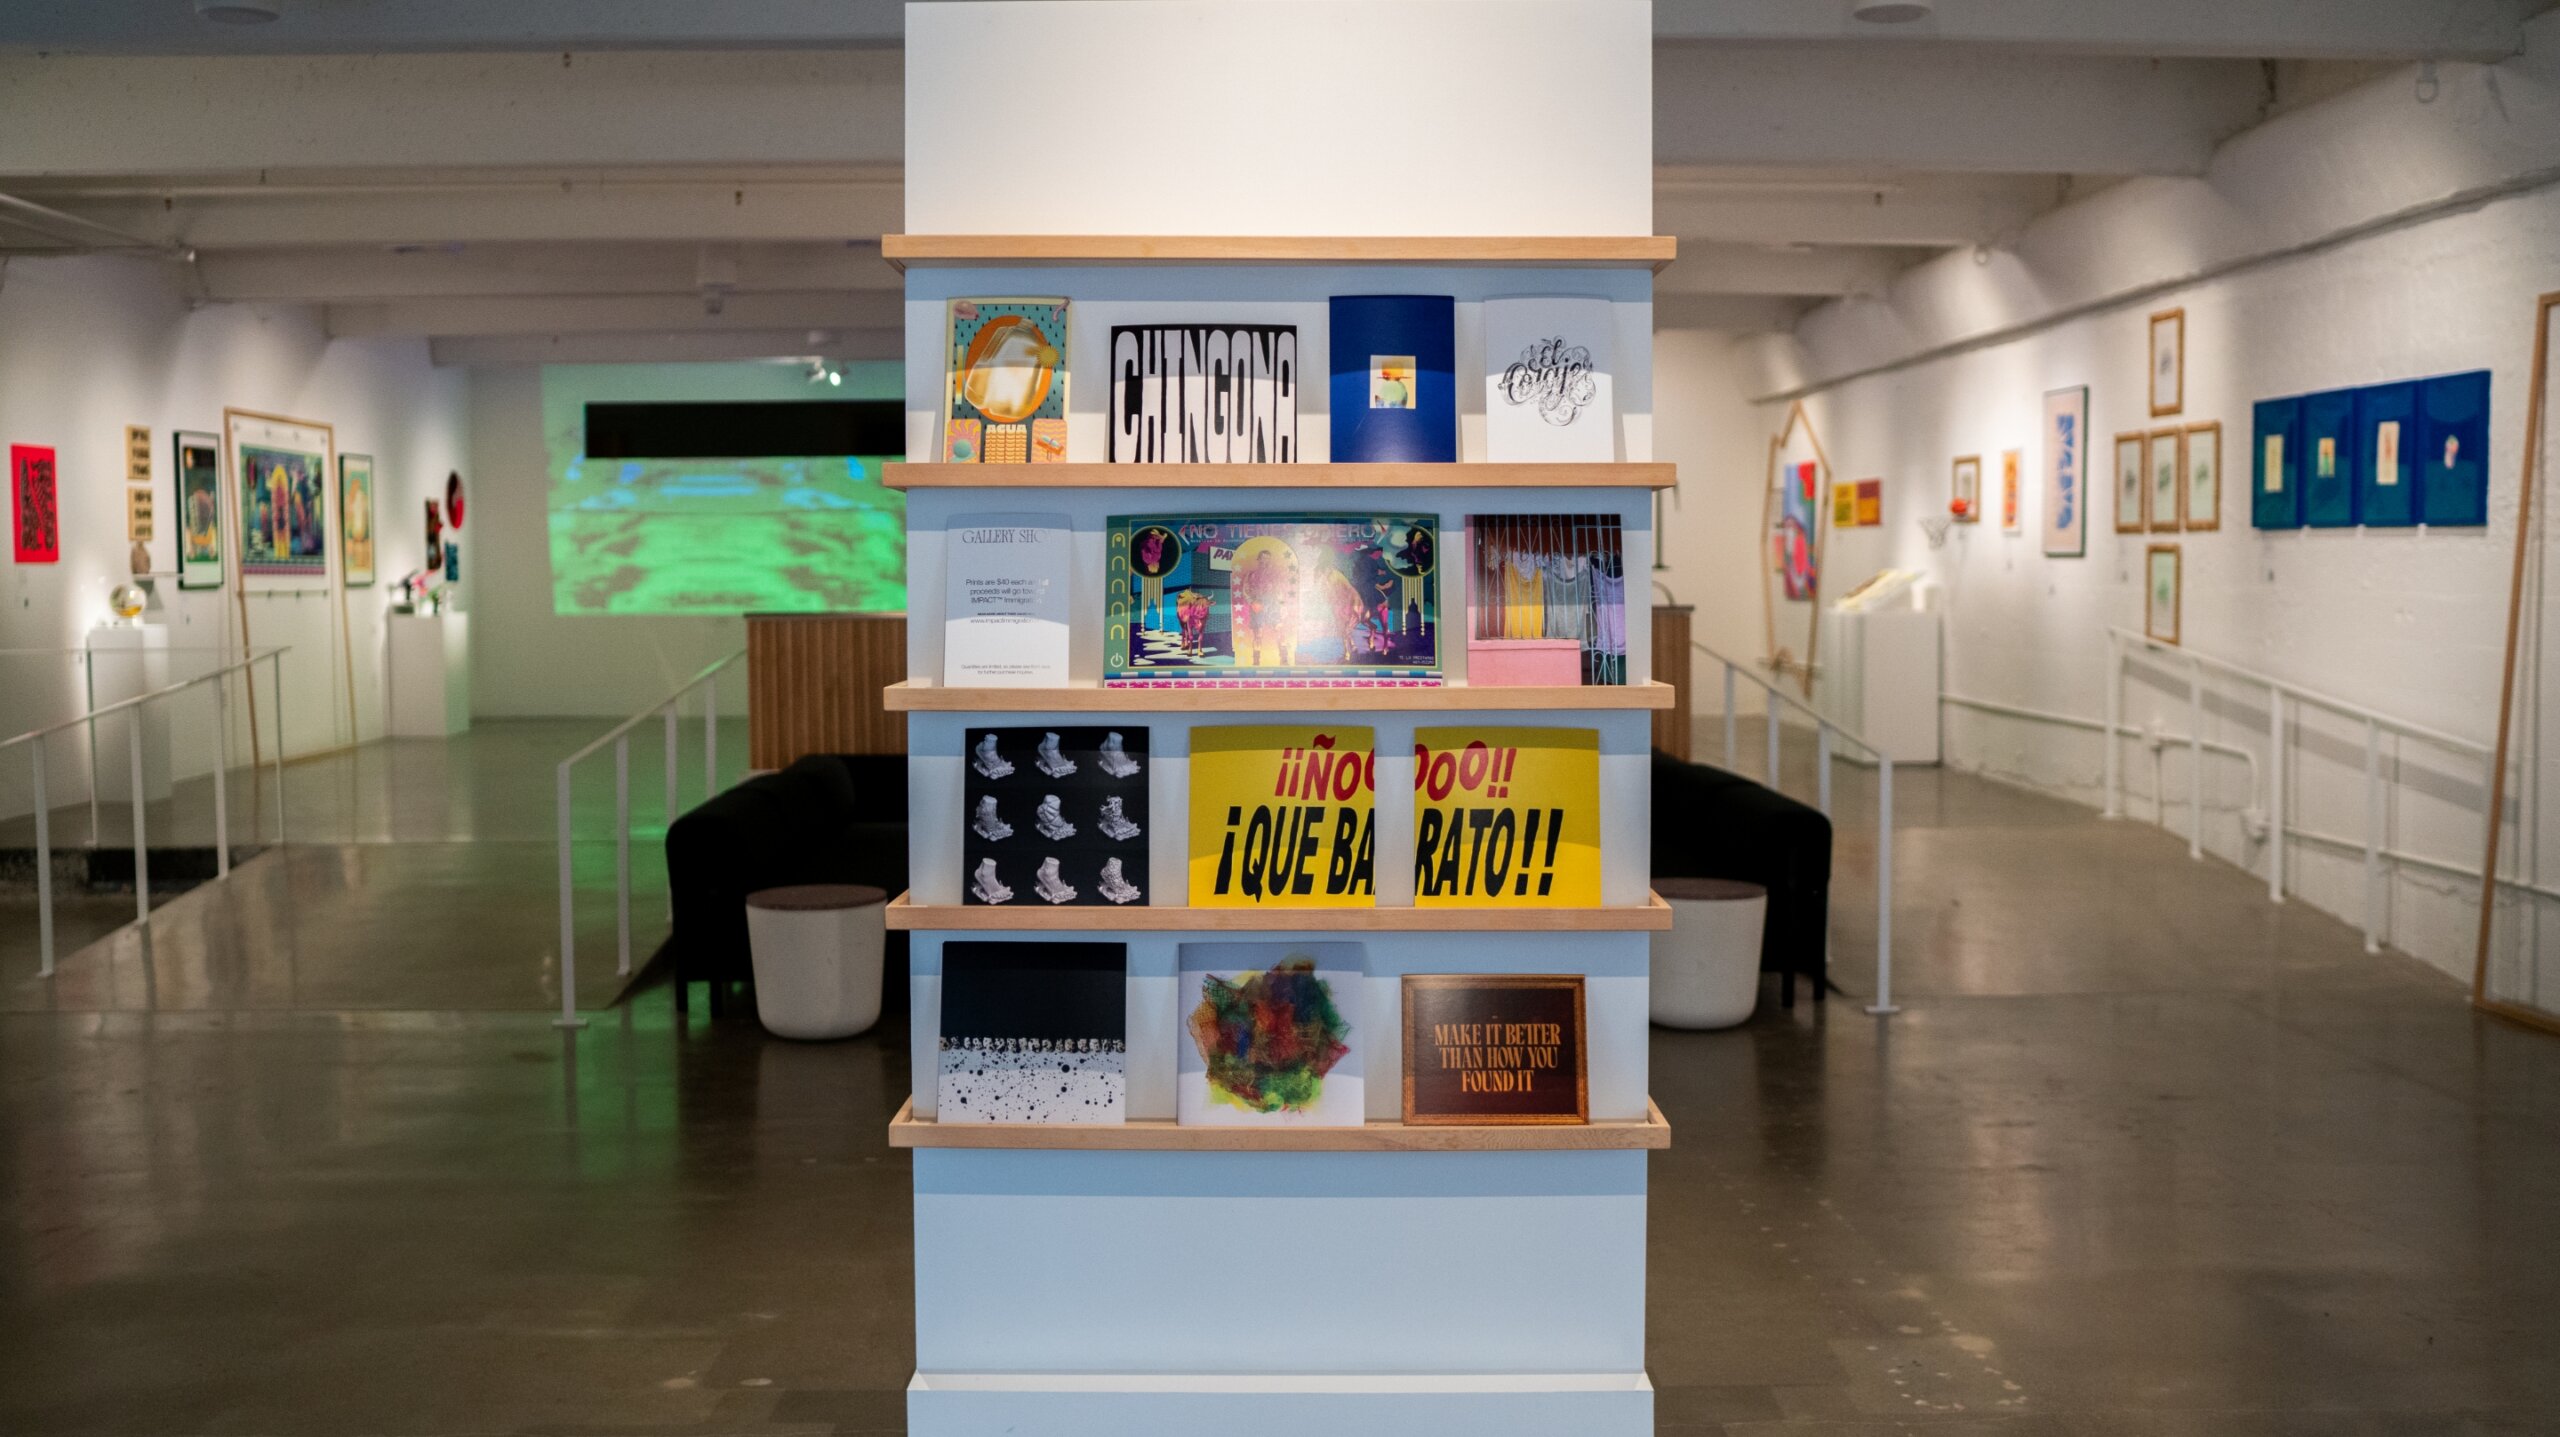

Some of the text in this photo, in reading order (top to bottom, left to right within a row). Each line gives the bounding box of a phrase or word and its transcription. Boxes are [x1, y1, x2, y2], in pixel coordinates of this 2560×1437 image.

[1115, 329, 1297, 463] CHINGONA
[986, 423, 1027, 435] AGUA
[962, 529, 1048, 543] GALLERY SHO
[1190, 524, 1218, 539] NO
[966, 578, 984, 586] Prints
[1434, 1024, 1561, 1046] MAKE IT BETTER
[1439, 1047, 1558, 1069] THAN HOW YOU
[1462, 1070, 1535, 1092] FOUND IT
